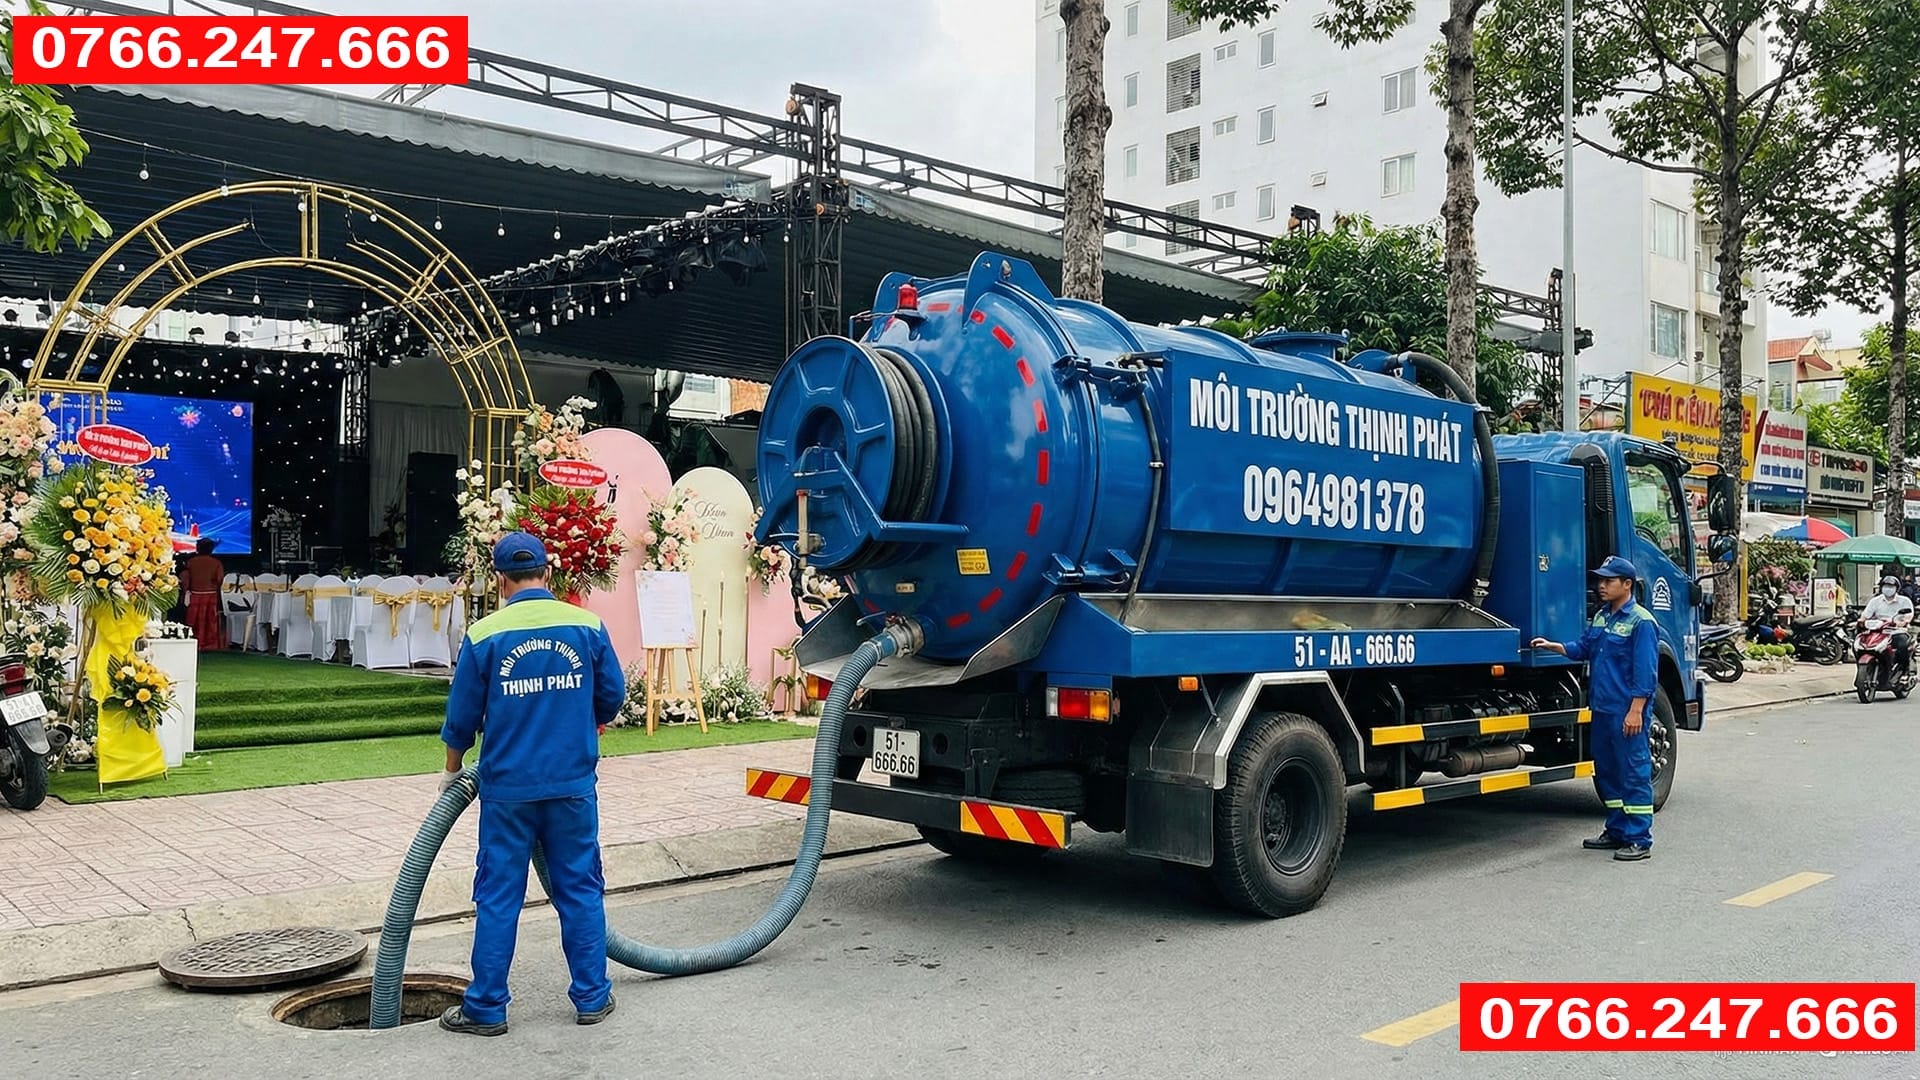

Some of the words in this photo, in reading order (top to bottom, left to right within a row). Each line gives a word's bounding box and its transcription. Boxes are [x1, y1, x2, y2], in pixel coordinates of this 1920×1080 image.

[1189, 371, 1240, 432] MÔI
[1246, 382, 1340, 447] TRƯỜNG
[1345, 404, 1408, 462] THỊNH
[1413, 411, 1462, 464] PHÁT
[1242, 464, 1425, 535] 0964981378
[499, 655, 516, 677] MÔI
[510, 637, 553, 659] TRƯỜNG
[1294, 635, 1314, 667] 51
[1329, 634, 1352, 666] AA
[1365, 633, 1415, 665] 666.66
[500, 677, 543, 697] THỊNH
[546, 671, 583, 690] PHÁT
[874, 751, 915, 774] 666.66
